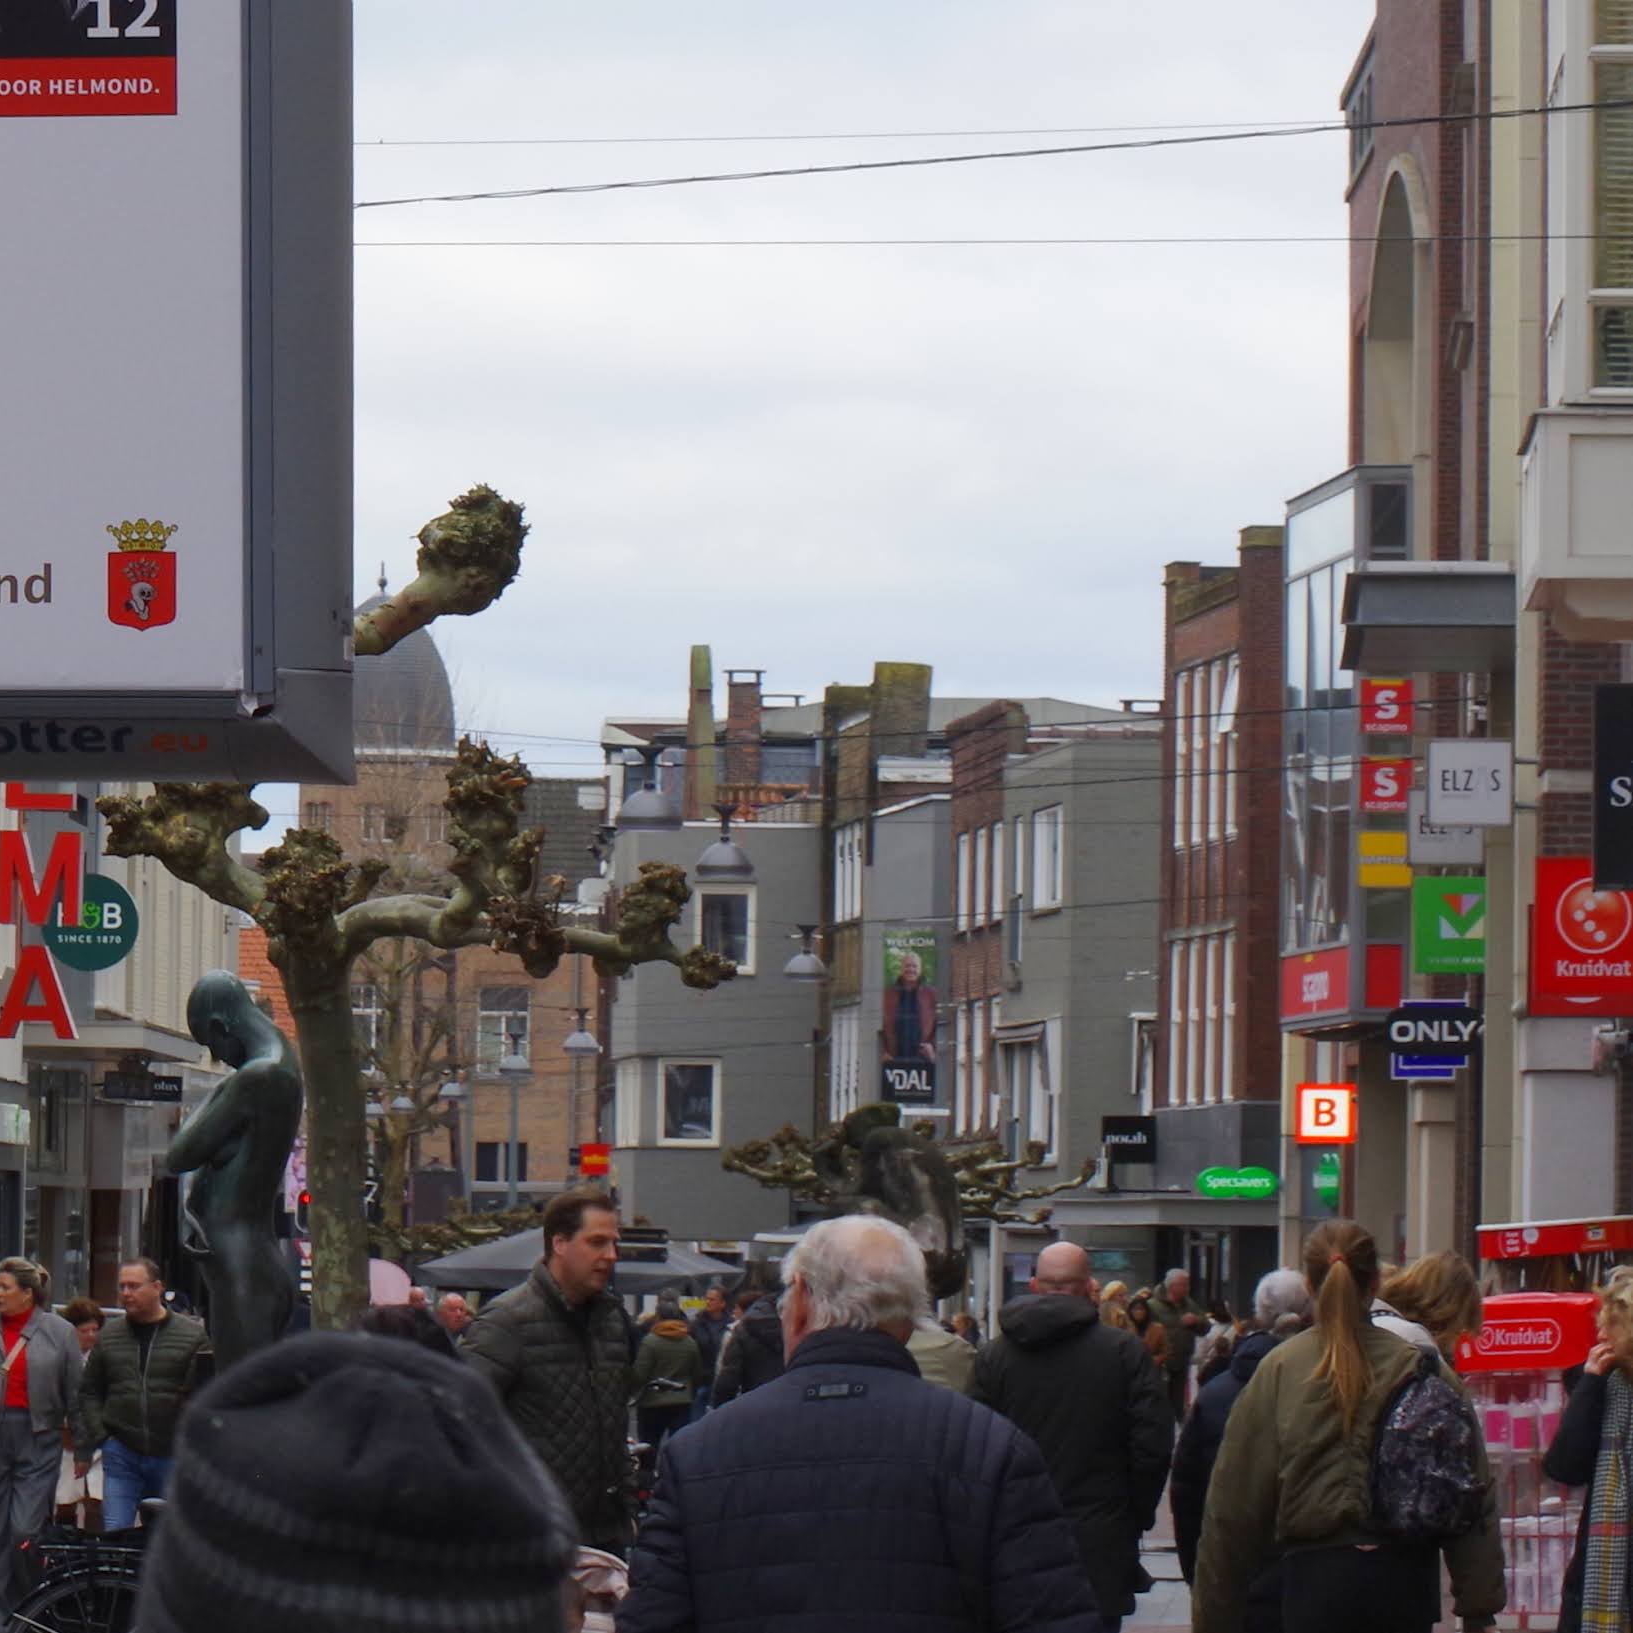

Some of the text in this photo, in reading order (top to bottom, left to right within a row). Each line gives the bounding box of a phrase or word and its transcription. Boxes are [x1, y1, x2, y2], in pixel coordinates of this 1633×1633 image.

[48, 74, 161, 95] HELMOND.
[1610, 776, 1633, 807] S
[58, 935, 122, 944] SINCE 1870
[1556, 959, 1631, 977] Kruidvat
[1391, 1020, 1477, 1043] ONLY
[1314, 1098, 1337, 1127] B
[1206, 1175, 1271, 1189] Specsavers
[1495, 1327, 1552, 1345] Kruidvat
